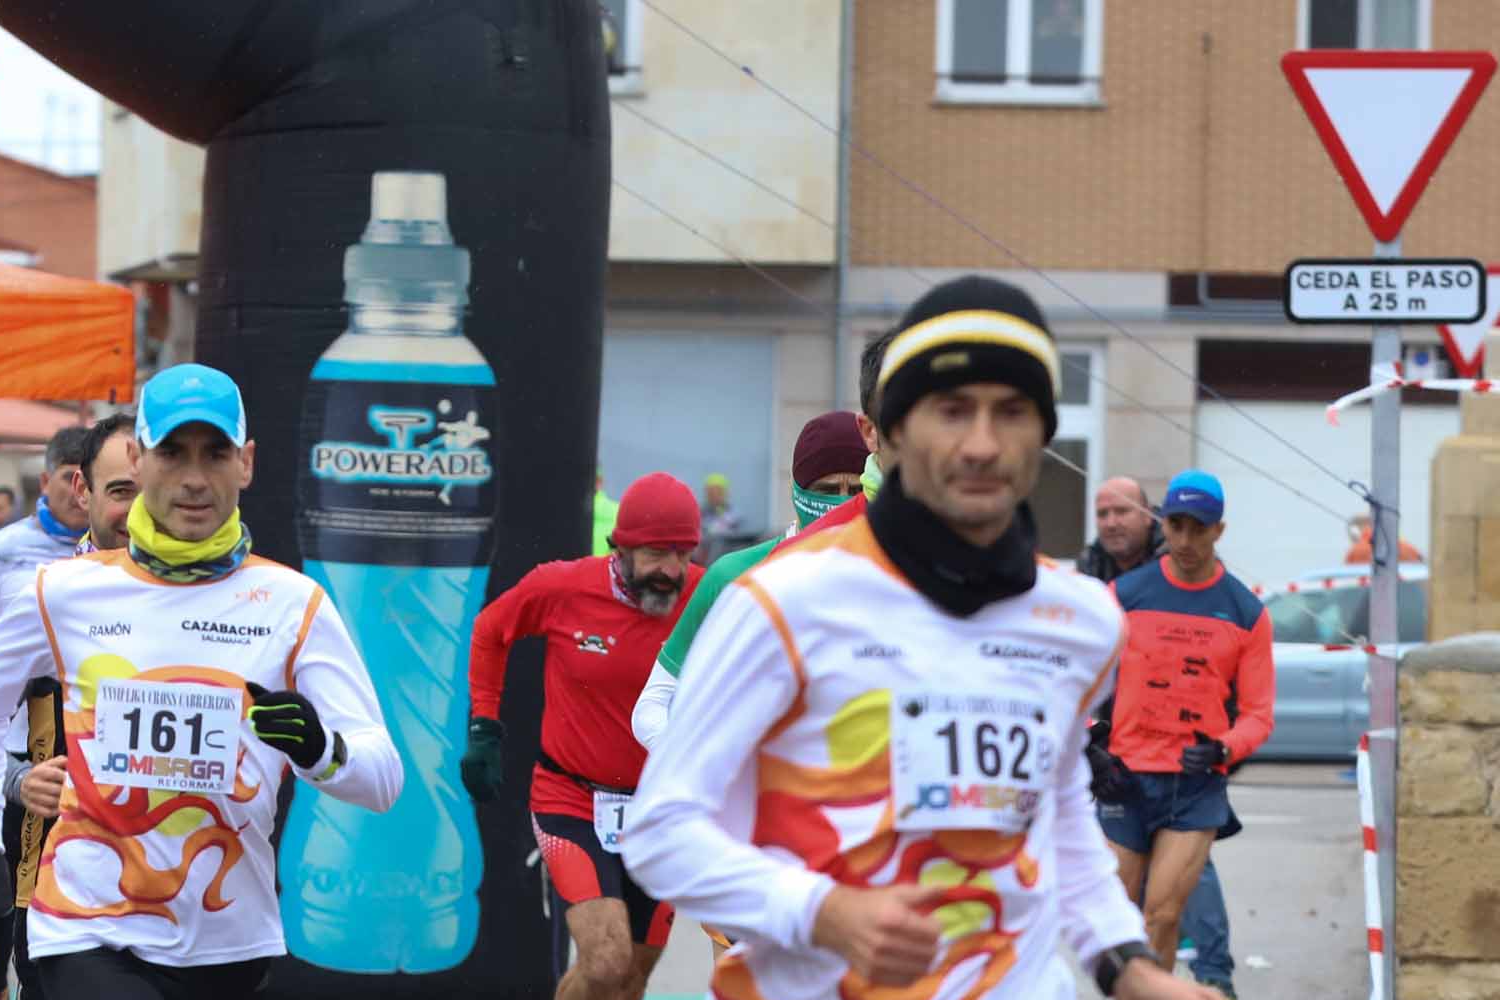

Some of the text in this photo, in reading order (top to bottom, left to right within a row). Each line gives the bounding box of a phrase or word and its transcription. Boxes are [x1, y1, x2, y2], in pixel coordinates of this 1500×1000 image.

[1296, 269, 1474, 289] CEDA EL PASO
[1343, 293, 1427, 311] A 25 m
[315, 447, 488, 476] POWERADE
[88, 621, 132, 638] RAMÓN
[125, 687, 146, 704] LIGA
[148, 690, 177, 706] CROSS
[178, 692, 236, 711] CARRERIZOS
[123, 707, 203, 756] 161
[936, 719, 1030, 781] 162
[101, 751, 225, 781] JOMISAGA
[157, 778, 223, 790] REFORMAS
[613, 804, 625, 831] 1
